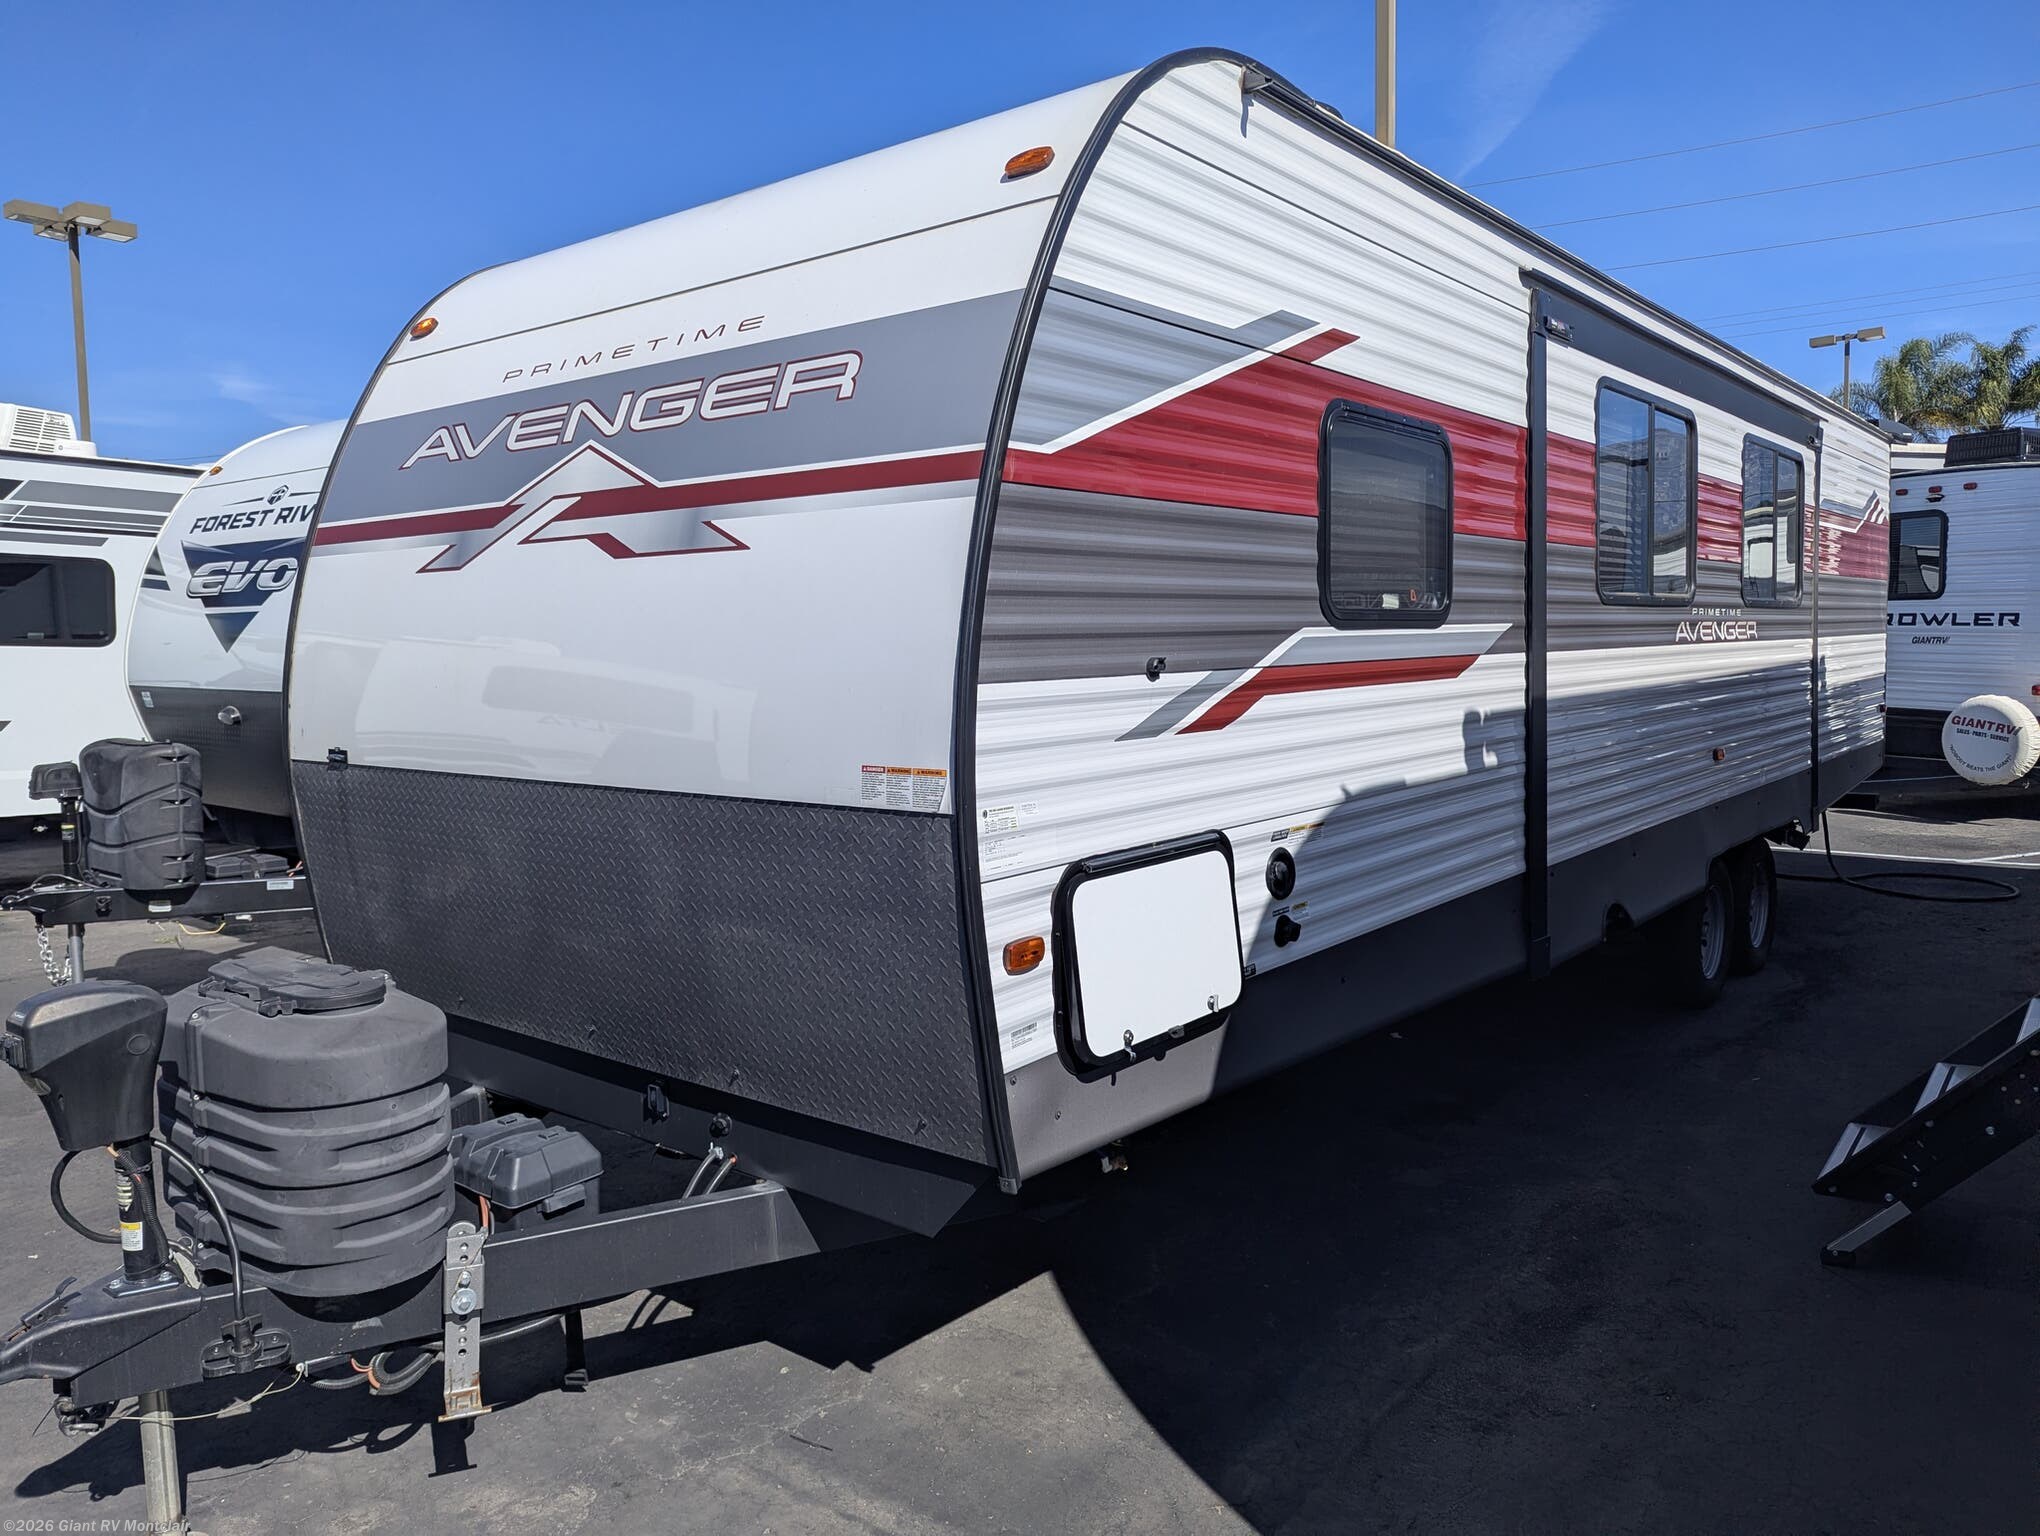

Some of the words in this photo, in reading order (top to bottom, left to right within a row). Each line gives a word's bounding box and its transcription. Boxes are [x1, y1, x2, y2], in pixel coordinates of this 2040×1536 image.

[502, 315, 766, 384] PRIMETIME
[398, 350, 864, 470] AVENGER
[189, 509, 274, 534] FOREST
[186, 557, 298, 598] EVO
[1691, 607, 1742, 617] PRIMETIME
[1675, 620, 1758, 642] AVENGER
[1911, 636, 1949, 645] GIANTRV
[1951, 715, 2020, 736] GIANTRV
